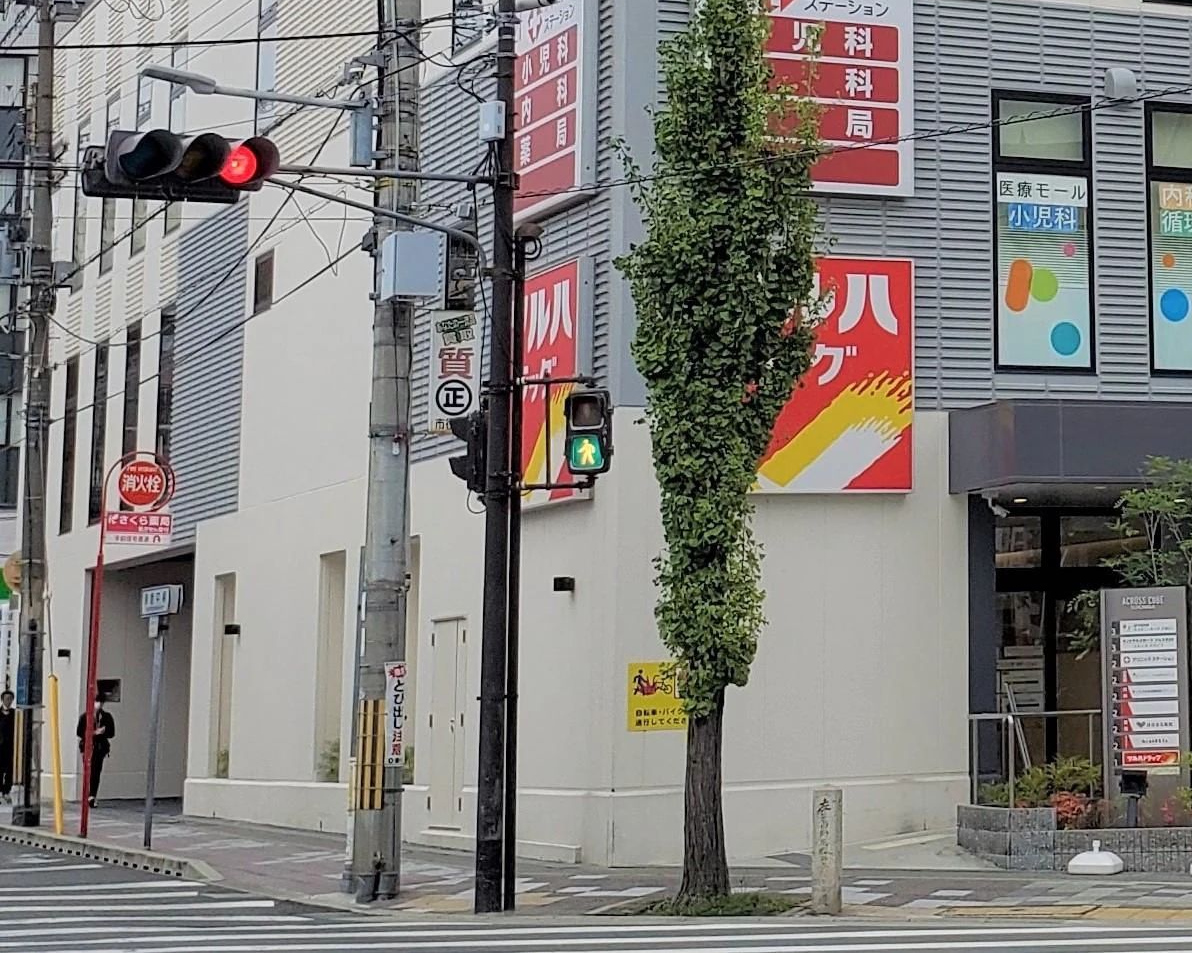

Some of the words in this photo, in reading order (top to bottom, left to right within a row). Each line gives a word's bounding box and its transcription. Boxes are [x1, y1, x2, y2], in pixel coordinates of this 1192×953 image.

[521, 32, 569, 85] 小児科
[844, 68, 874, 99] 科
[845, 109, 874, 139] 局
[1000, 179, 1086, 200] 医療モール
[1009, 205, 1077, 231] 小児科
[524, 279, 573, 352] ルハ
[438, 347, 475, 379] 質
[122, 474, 162, 493] 消火栓
